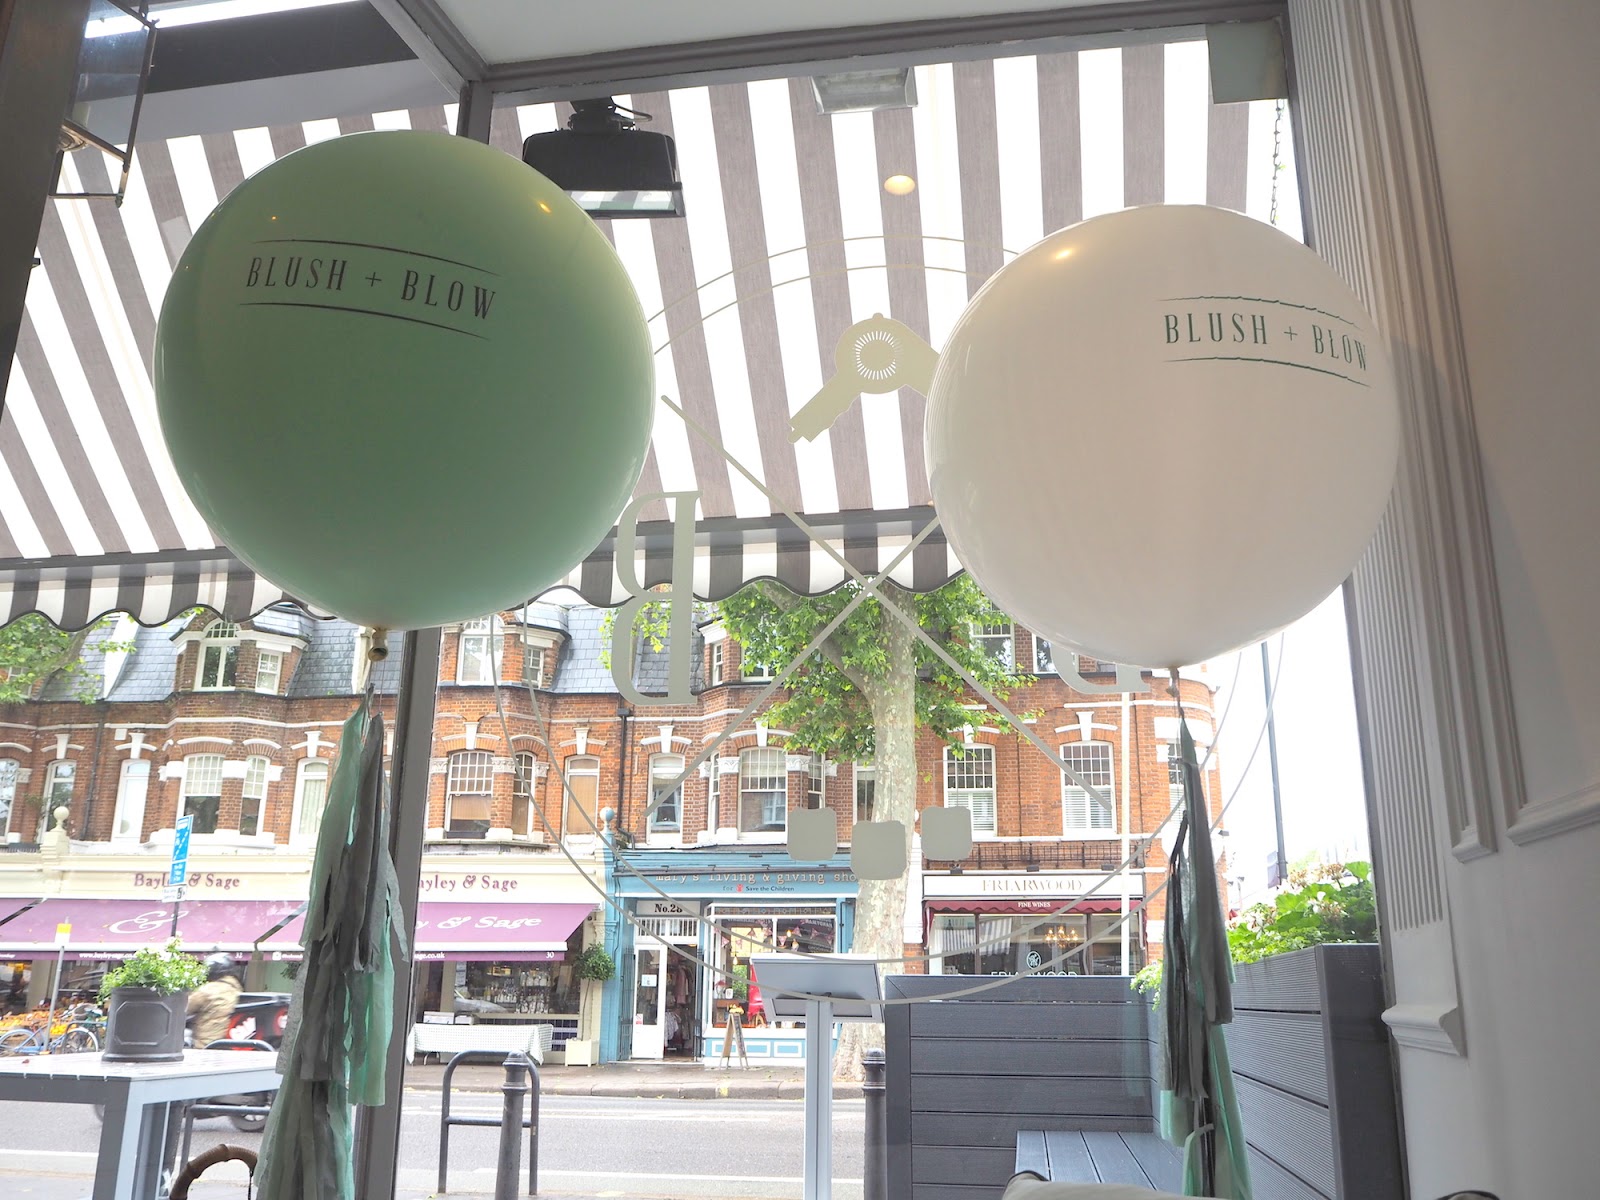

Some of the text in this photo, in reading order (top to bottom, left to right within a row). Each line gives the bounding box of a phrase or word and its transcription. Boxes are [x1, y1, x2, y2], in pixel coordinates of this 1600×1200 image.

[246, 256, 347, 291] BLUSH
[401, 269, 496, 320] BLOW
[1164, 313, 1268, 345] BLUSH
[1312, 324, 1367, 371] BLOW
[134, 873, 170, 889] Bayl
[188, 873, 201, 887] &
[205, 873, 240, 890] Sage
[462, 875, 477, 889] &
[481, 875, 518, 892] Sage
[777, 871, 825, 885] giving
[833, 871, 858, 882] sho
[983, 879, 1082, 891] FRIARWOOD
[770, 885, 795, 893] Children
[474, 916, 542, 930] Sage
